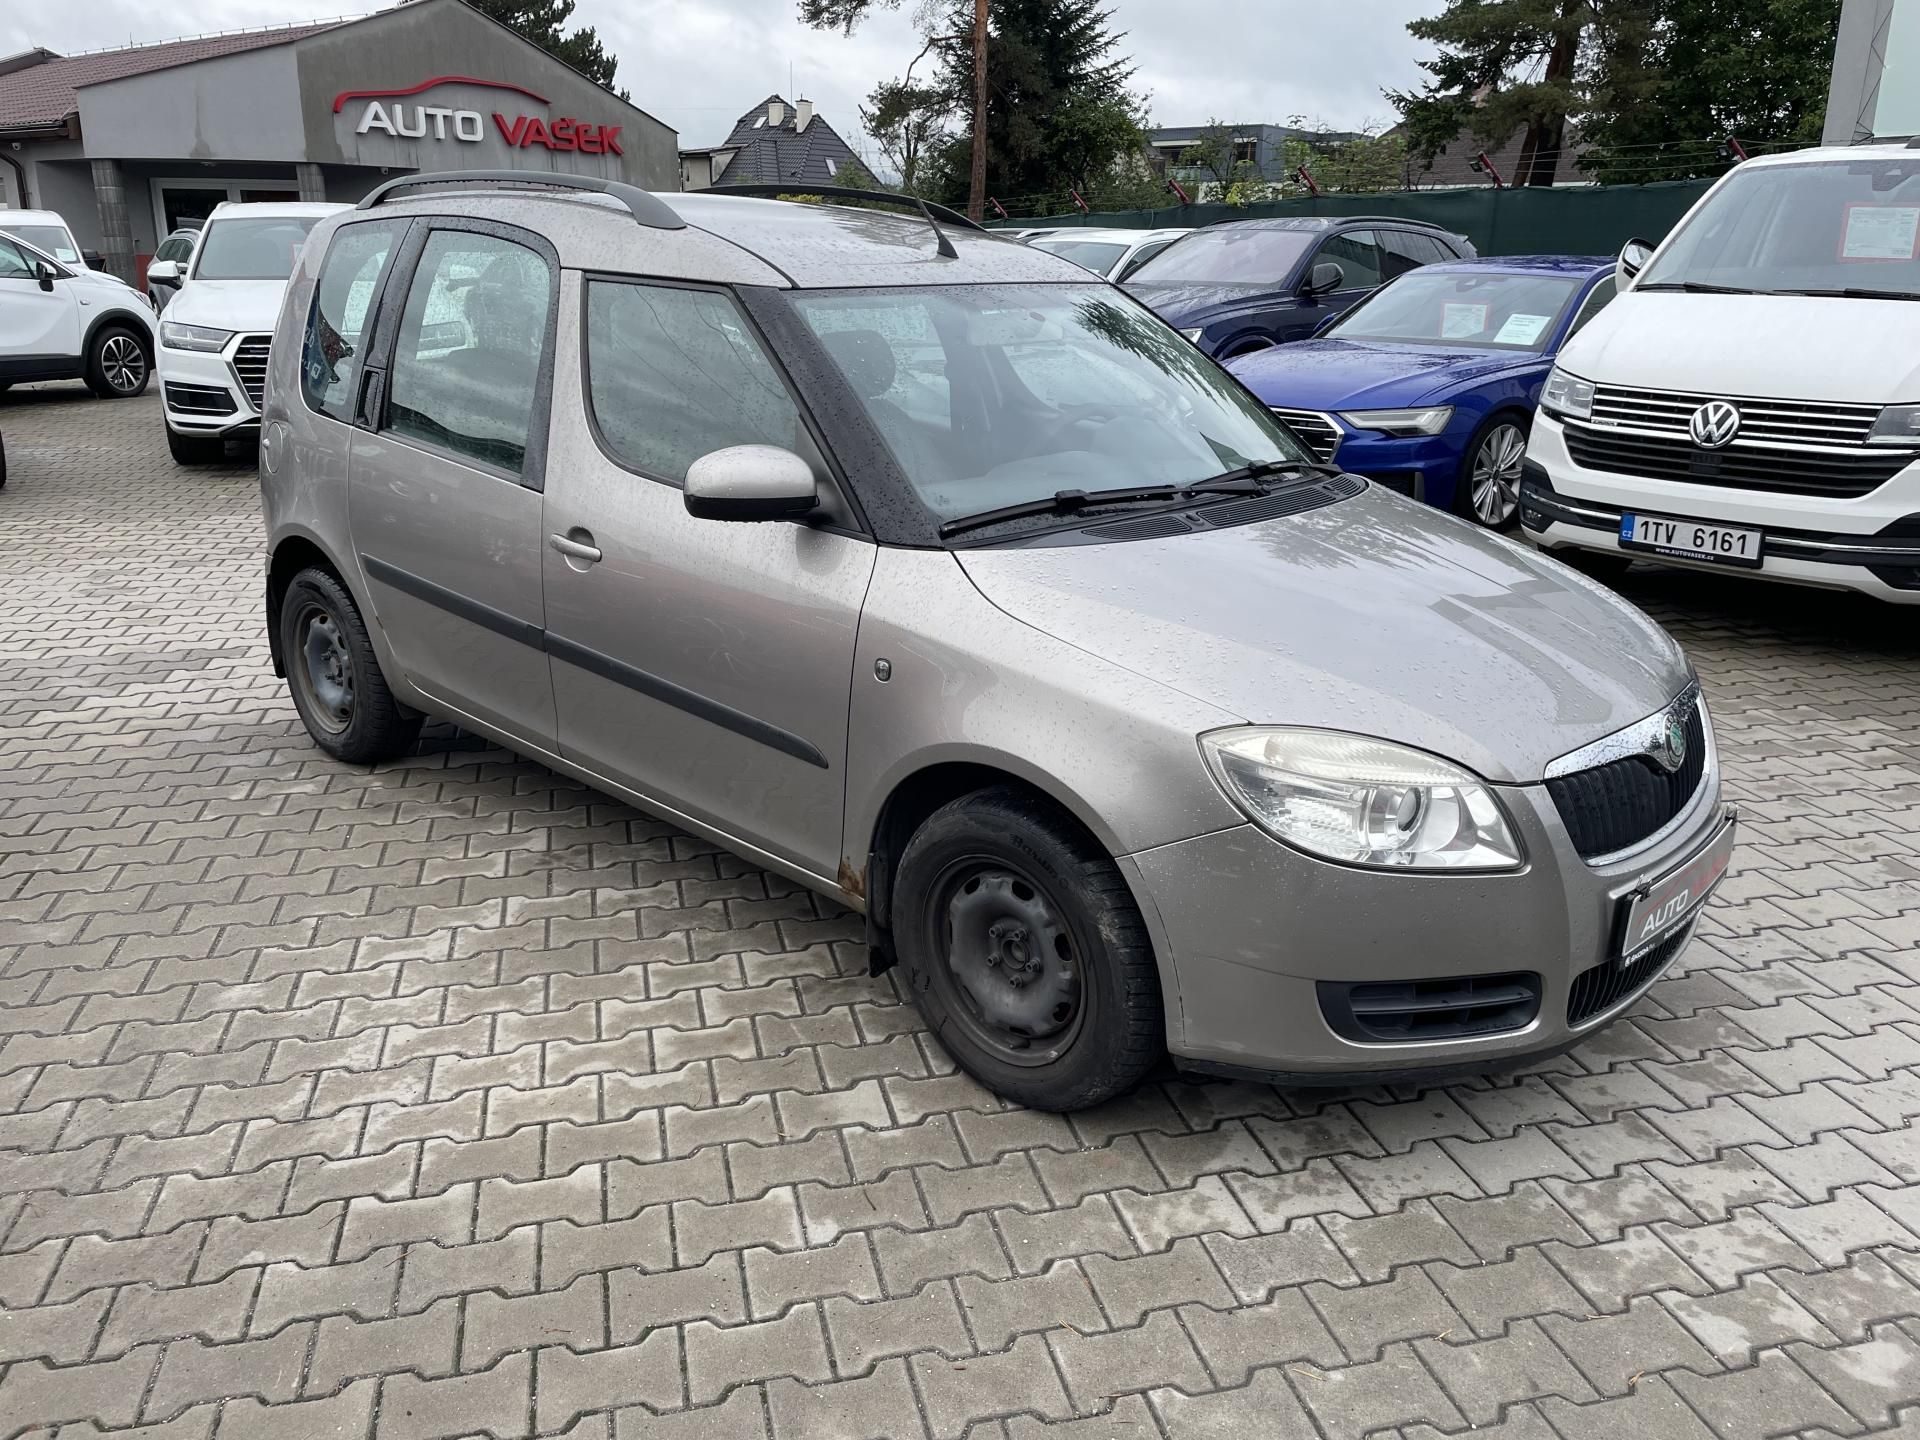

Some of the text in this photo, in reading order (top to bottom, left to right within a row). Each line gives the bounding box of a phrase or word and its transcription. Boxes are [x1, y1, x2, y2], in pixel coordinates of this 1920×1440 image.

[355, 101, 485, 142] AUTO
[1622, 530, 1633, 538] CZ
[1640, 520, 1748, 555] 1TV 6161
[1640, 888, 1689, 939] AUTO
